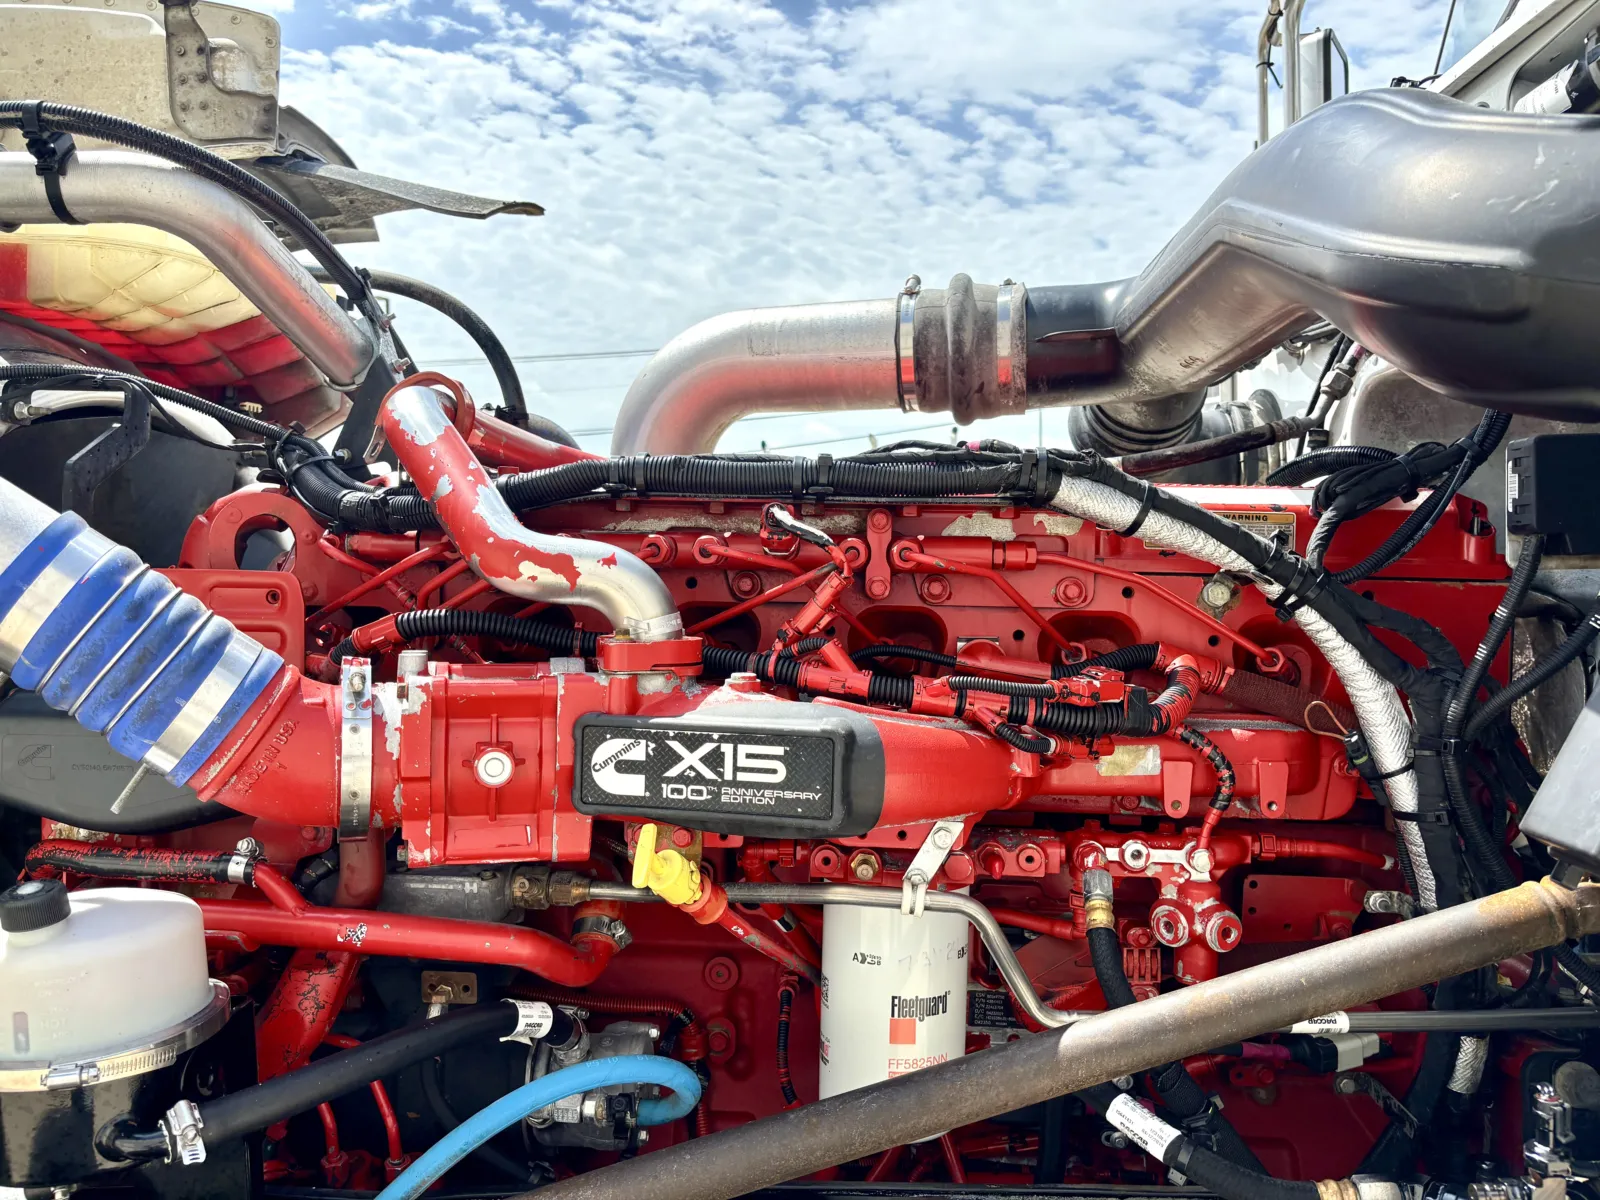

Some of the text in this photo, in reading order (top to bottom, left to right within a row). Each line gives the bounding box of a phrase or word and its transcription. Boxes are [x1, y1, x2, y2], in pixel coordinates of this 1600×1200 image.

[1223, 514, 1268, 522] WARNING
[592, 737, 641, 774] Cummins
[662, 740, 787, 784] X15
[721, 787, 823, 802] ANNIVERSARY
[721, 795, 775, 806] EDITION
[852, 952, 860, 963] A
[890, 994, 948, 1022] Fleetguard
[888, 1053, 948, 1069] FF5825NN
